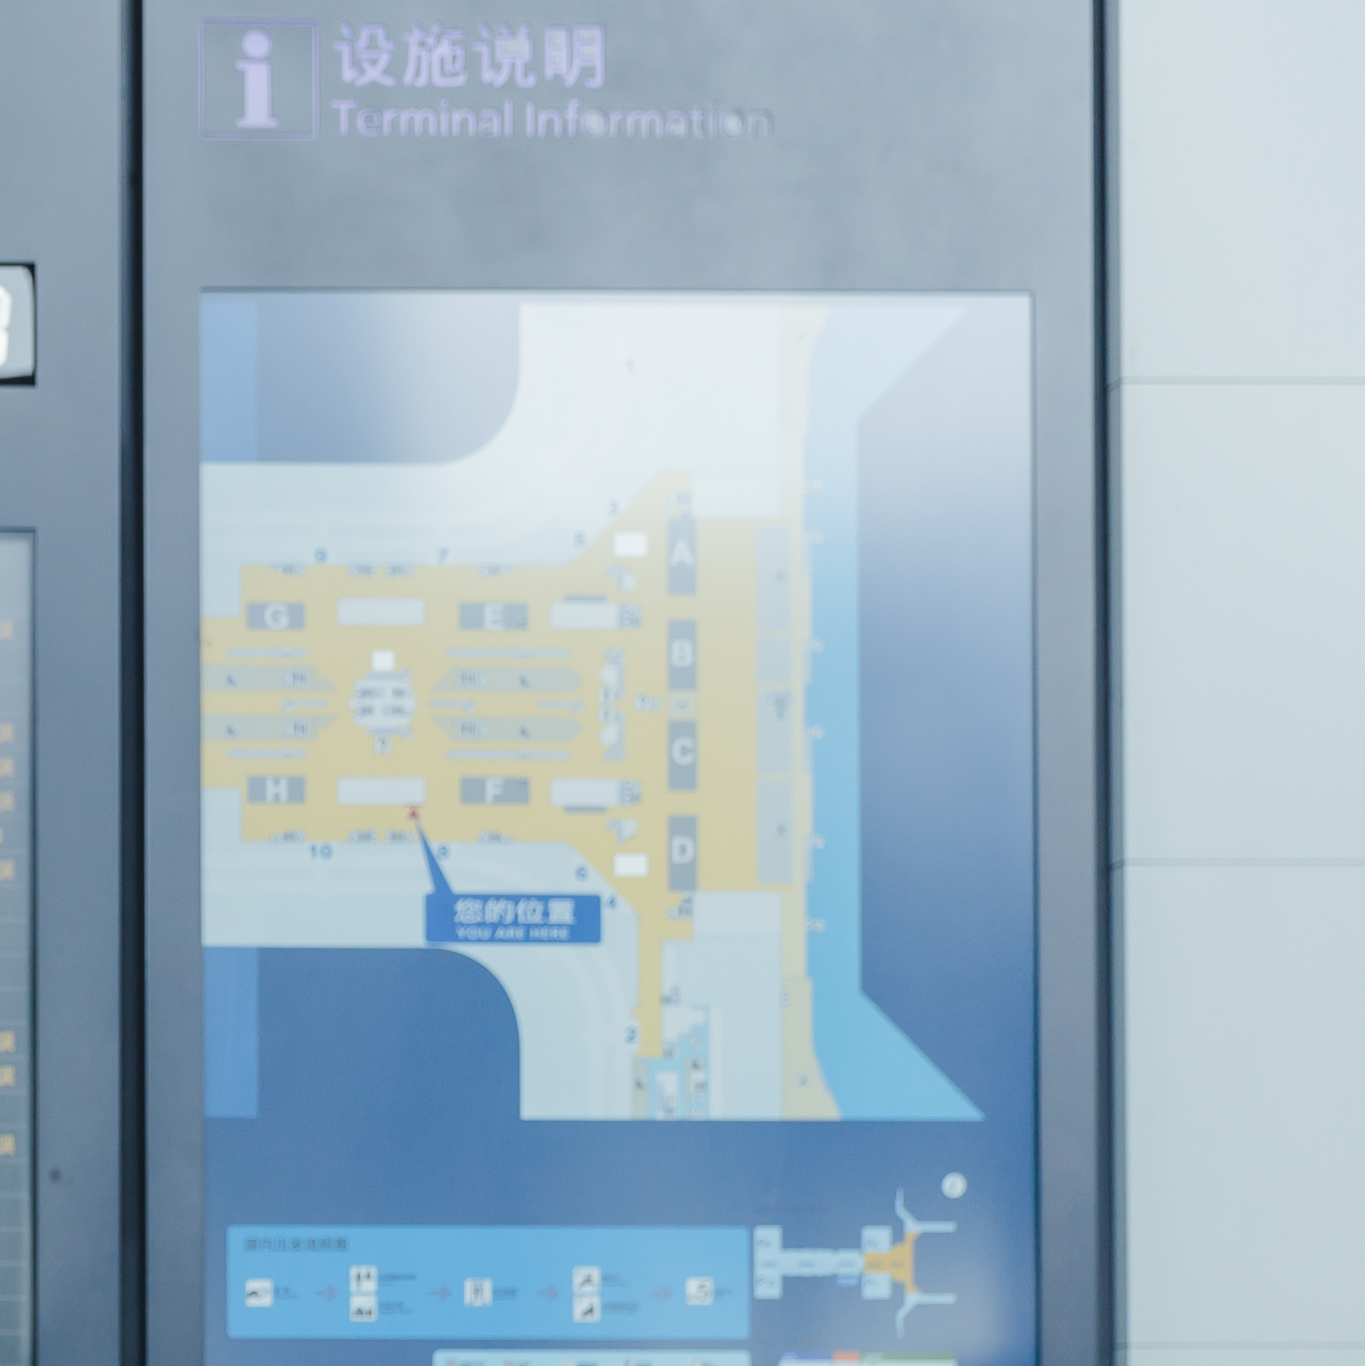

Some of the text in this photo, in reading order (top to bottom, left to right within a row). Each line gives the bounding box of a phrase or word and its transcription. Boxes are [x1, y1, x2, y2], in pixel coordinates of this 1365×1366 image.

[335, 22, 606, 88] 设施说明
[330, 99, 773, 138] Terminal Information
[670, 538, 694, 567] A
[264, 604, 290, 631] G
[671, 638, 694, 668] B
[671, 736, 695, 765] C
[265, 778, 288, 804] H
[671, 836, 695, 864] D
[453, 898, 576, 925] 您的位置
[455, 926, 493, 940] YOU
[529, 926, 568, 940] HERE
